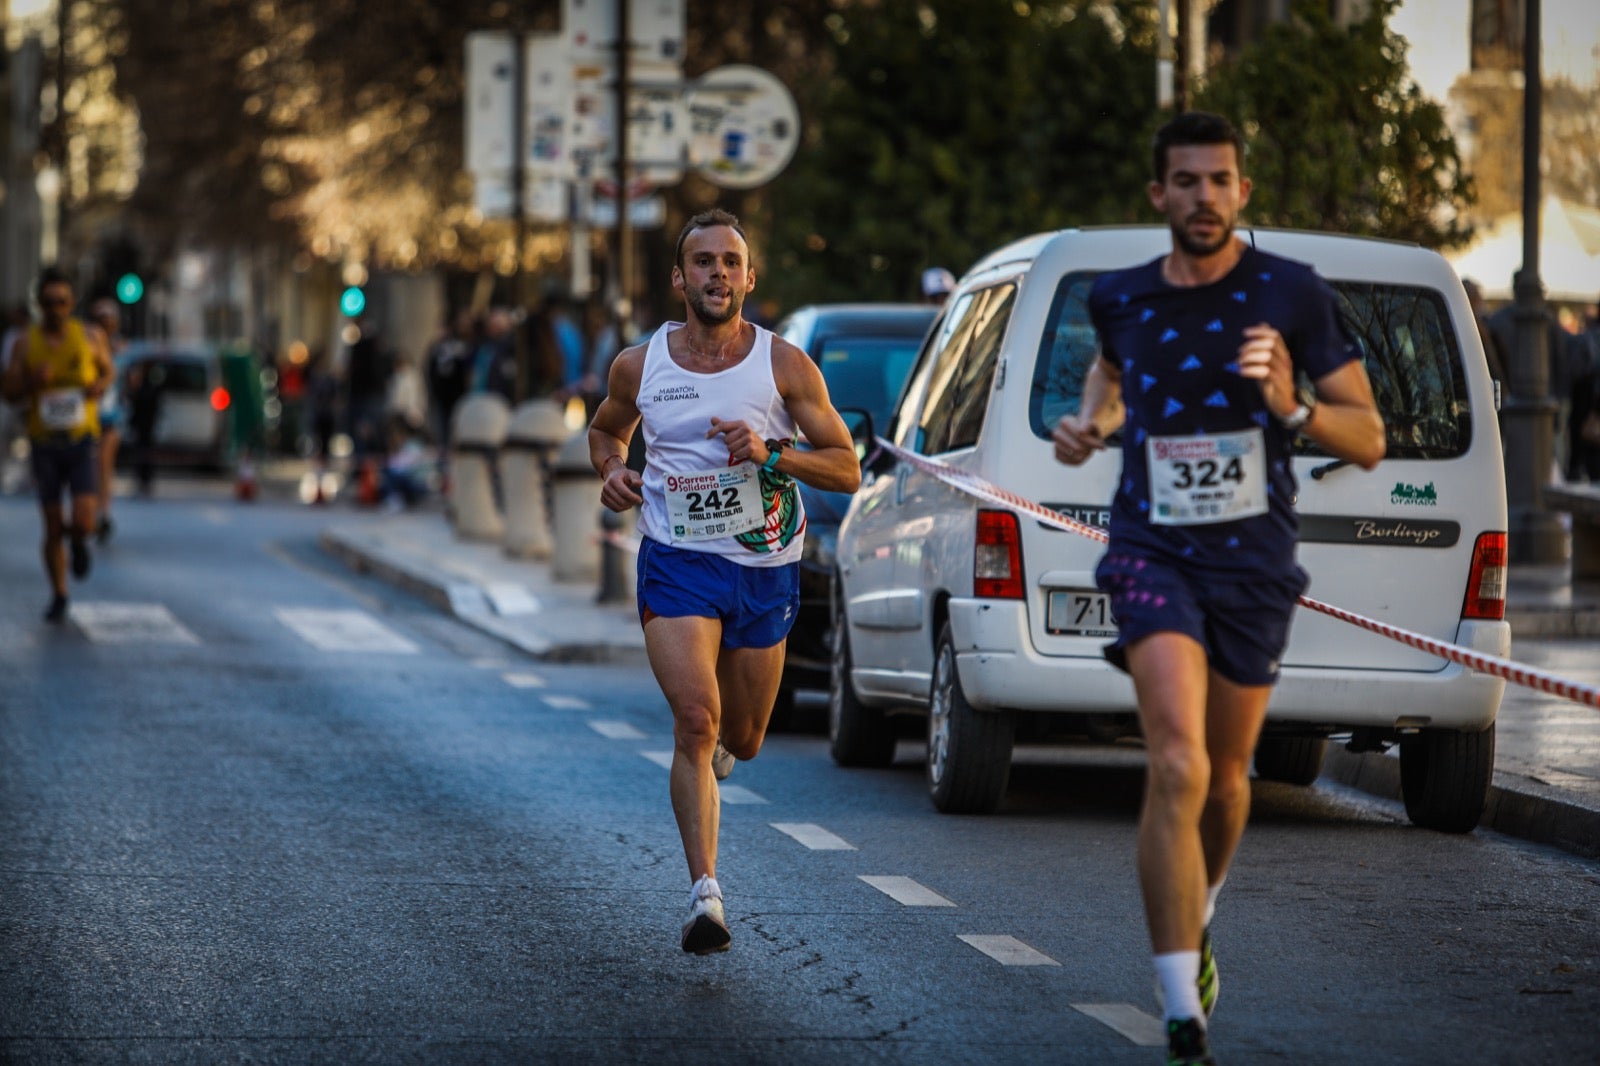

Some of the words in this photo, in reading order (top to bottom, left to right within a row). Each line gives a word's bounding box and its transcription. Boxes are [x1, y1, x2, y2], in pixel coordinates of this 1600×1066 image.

[659, 385, 695, 394] MARATÓN
[664, 393, 700, 401] GRANADA
[1156, 441, 1168, 461] 9
[1172, 456, 1245, 489] 324
[667, 476, 678, 493] 9
[678, 475, 715, 484] Carrera
[679, 482, 719, 492] Solidaria
[686, 487, 741, 513] 242
[688, 513, 711, 521] PABLO
[1354, 519, 1441, 544] Berlingo
[1074, 596, 1118, 626] 71
